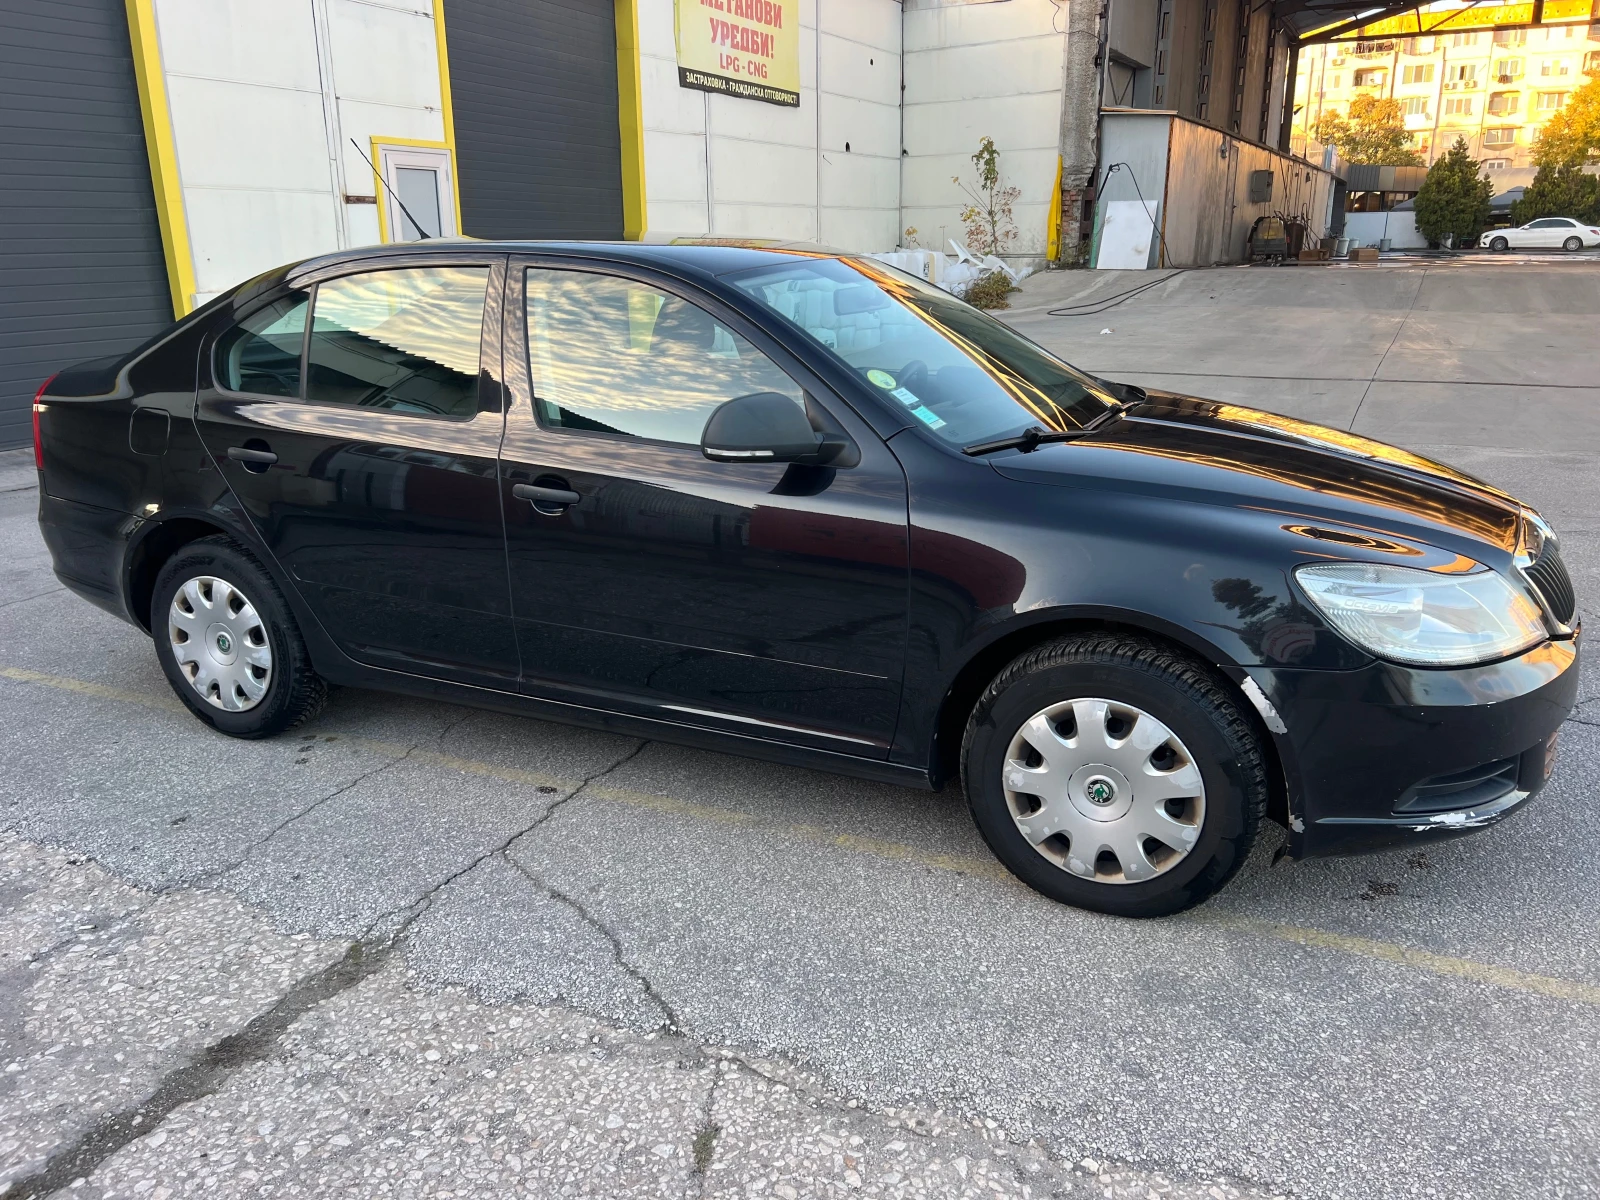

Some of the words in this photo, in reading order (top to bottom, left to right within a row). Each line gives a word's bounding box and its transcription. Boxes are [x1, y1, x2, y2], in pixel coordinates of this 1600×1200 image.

[700, 0, 782, 29] ТАНОВИ
[709, 17, 774, 59] УРЕДБИ!
[720, 53, 740, 73] LPG
[748, 60, 767, 79] CNG
[686, 72, 727, 90] ЗАСТРАХОВКА
[729, 81, 764, 98] ГРАЖДАНСКА
